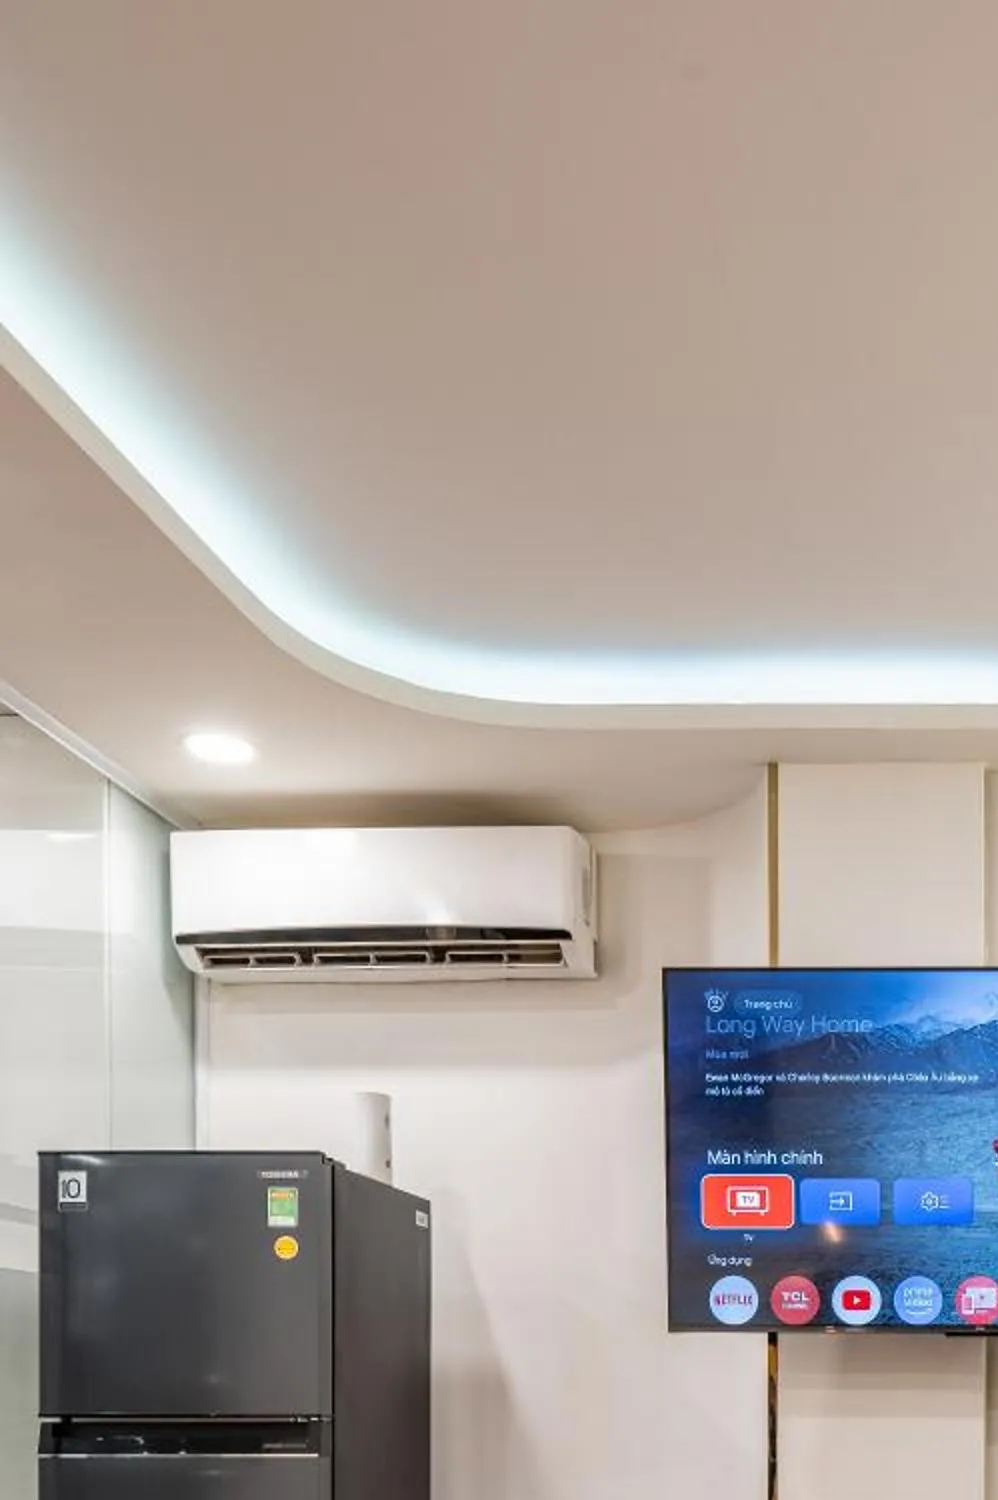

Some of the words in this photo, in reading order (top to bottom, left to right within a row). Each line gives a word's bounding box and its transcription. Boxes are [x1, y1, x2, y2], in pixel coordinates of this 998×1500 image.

[744, 999, 772, 1011] Trang
[706, 1015, 757, 1039] Long
[761, 1015, 805, 1037] Way
[811, 1015, 874, 1034] Home
[707, 1148, 741, 1165] Màn
[745, 1148, 778, 1165] hình
[781, 1148, 824, 1165] chính
[741, 1195, 755, 1205] TV
[781, 1292, 809, 1302] TCL
